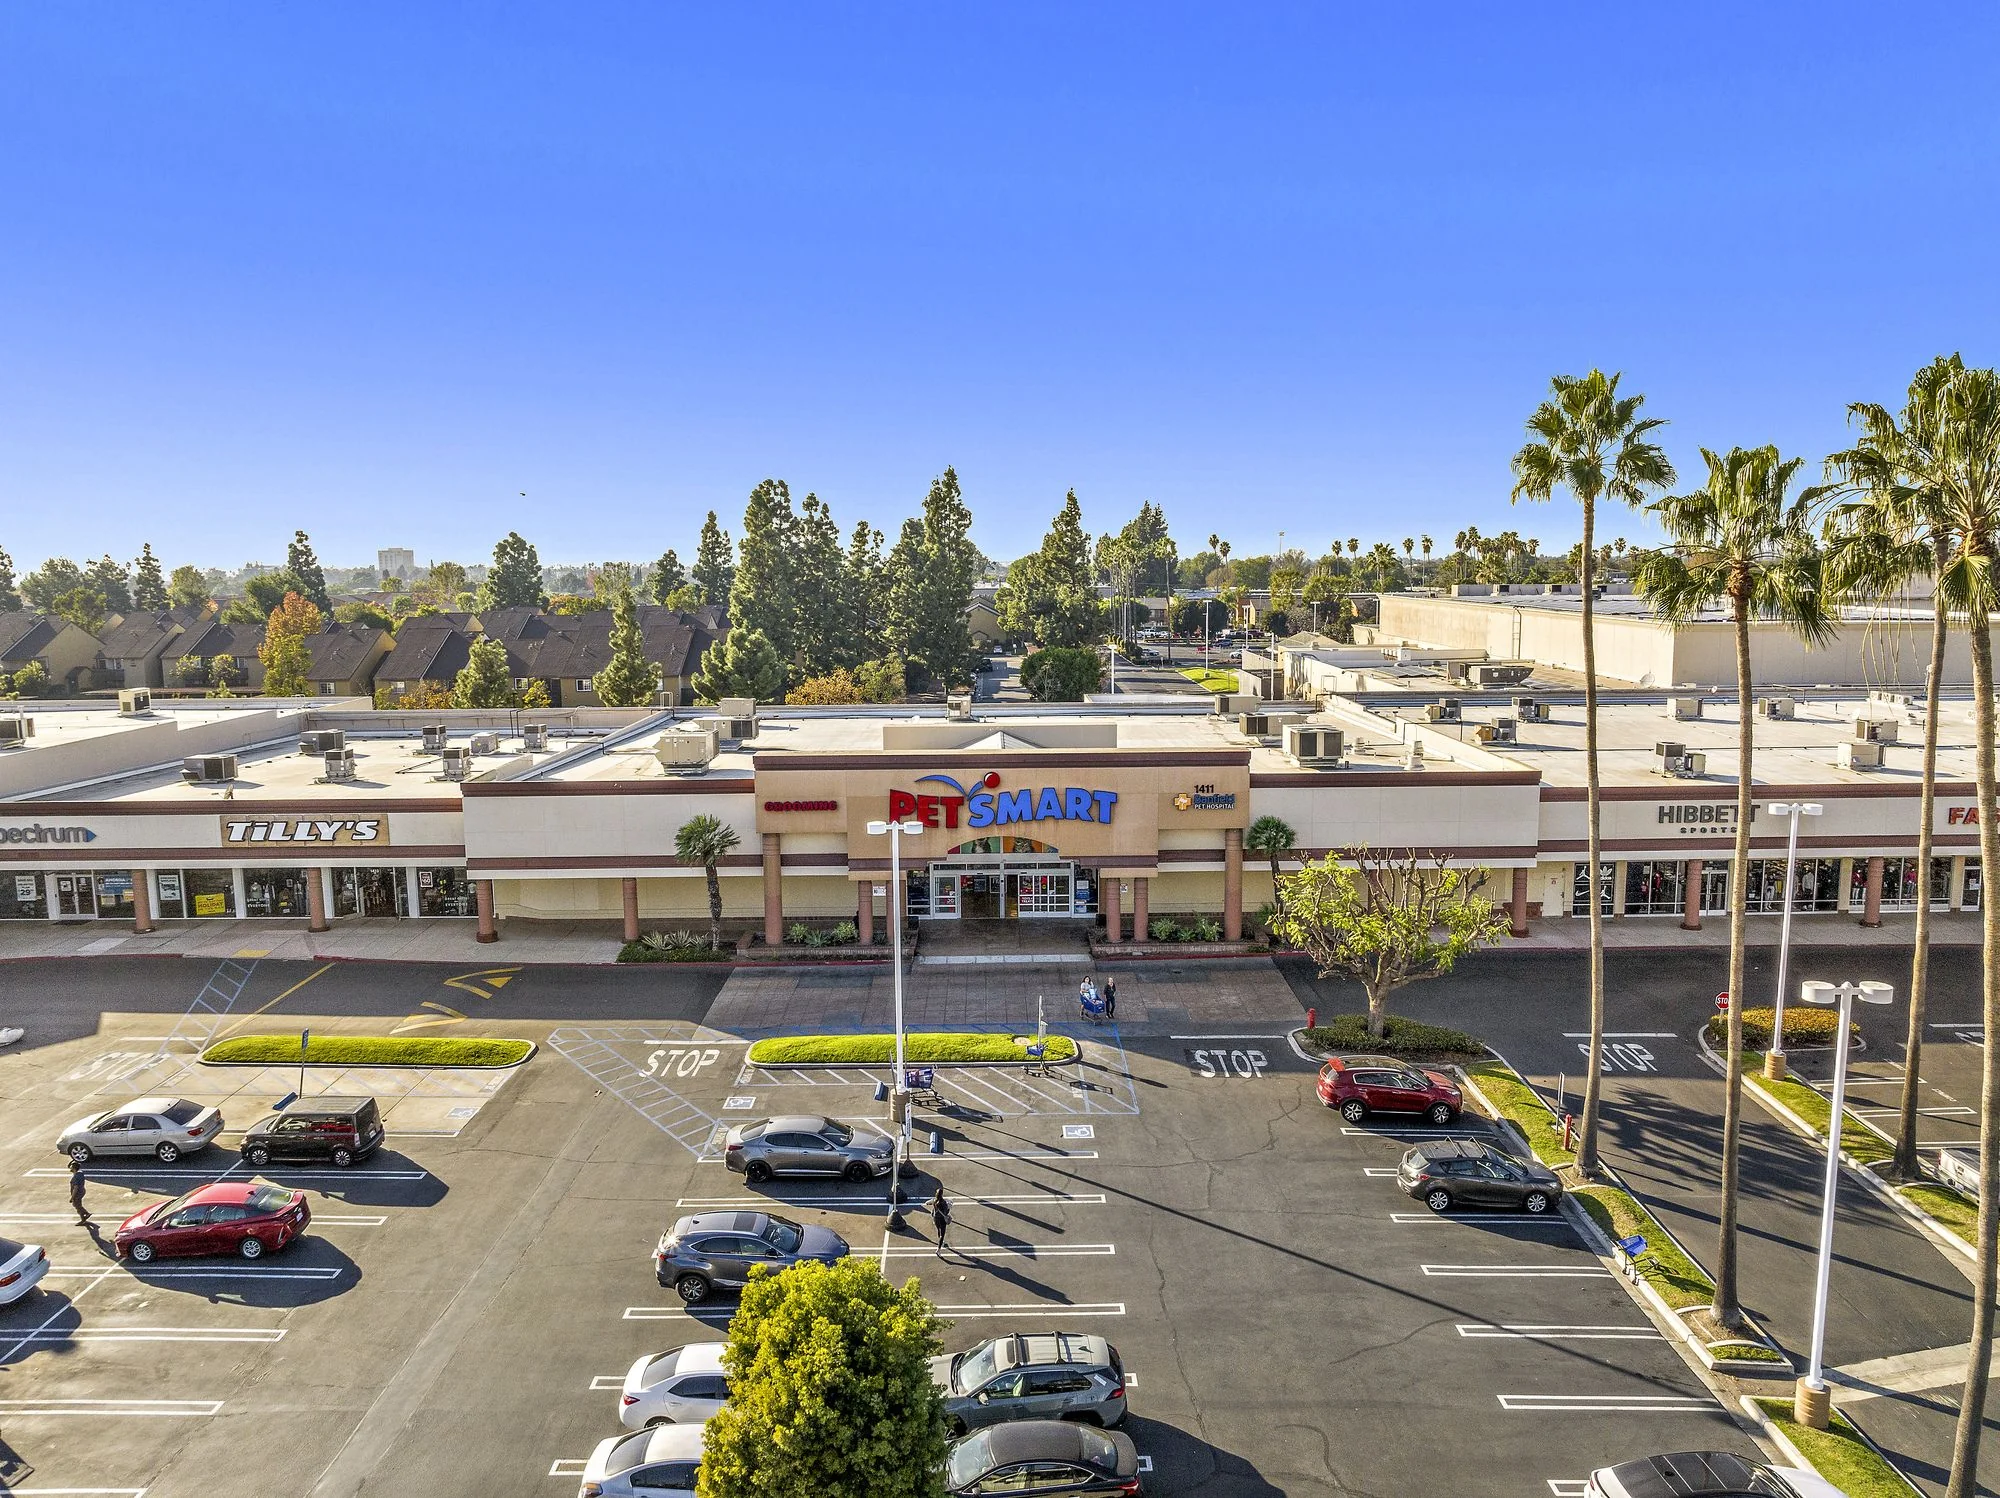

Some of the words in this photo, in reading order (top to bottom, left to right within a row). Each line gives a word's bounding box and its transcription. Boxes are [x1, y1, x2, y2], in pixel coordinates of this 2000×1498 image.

[1194, 785, 1214, 793] 1411
[764, 801, 838, 811] GROOMING
[889, 787, 1118, 829] PETSMART
[639, 1050, 720, 1078] STOP
[1194, 1050, 1268, 1078] STOP
